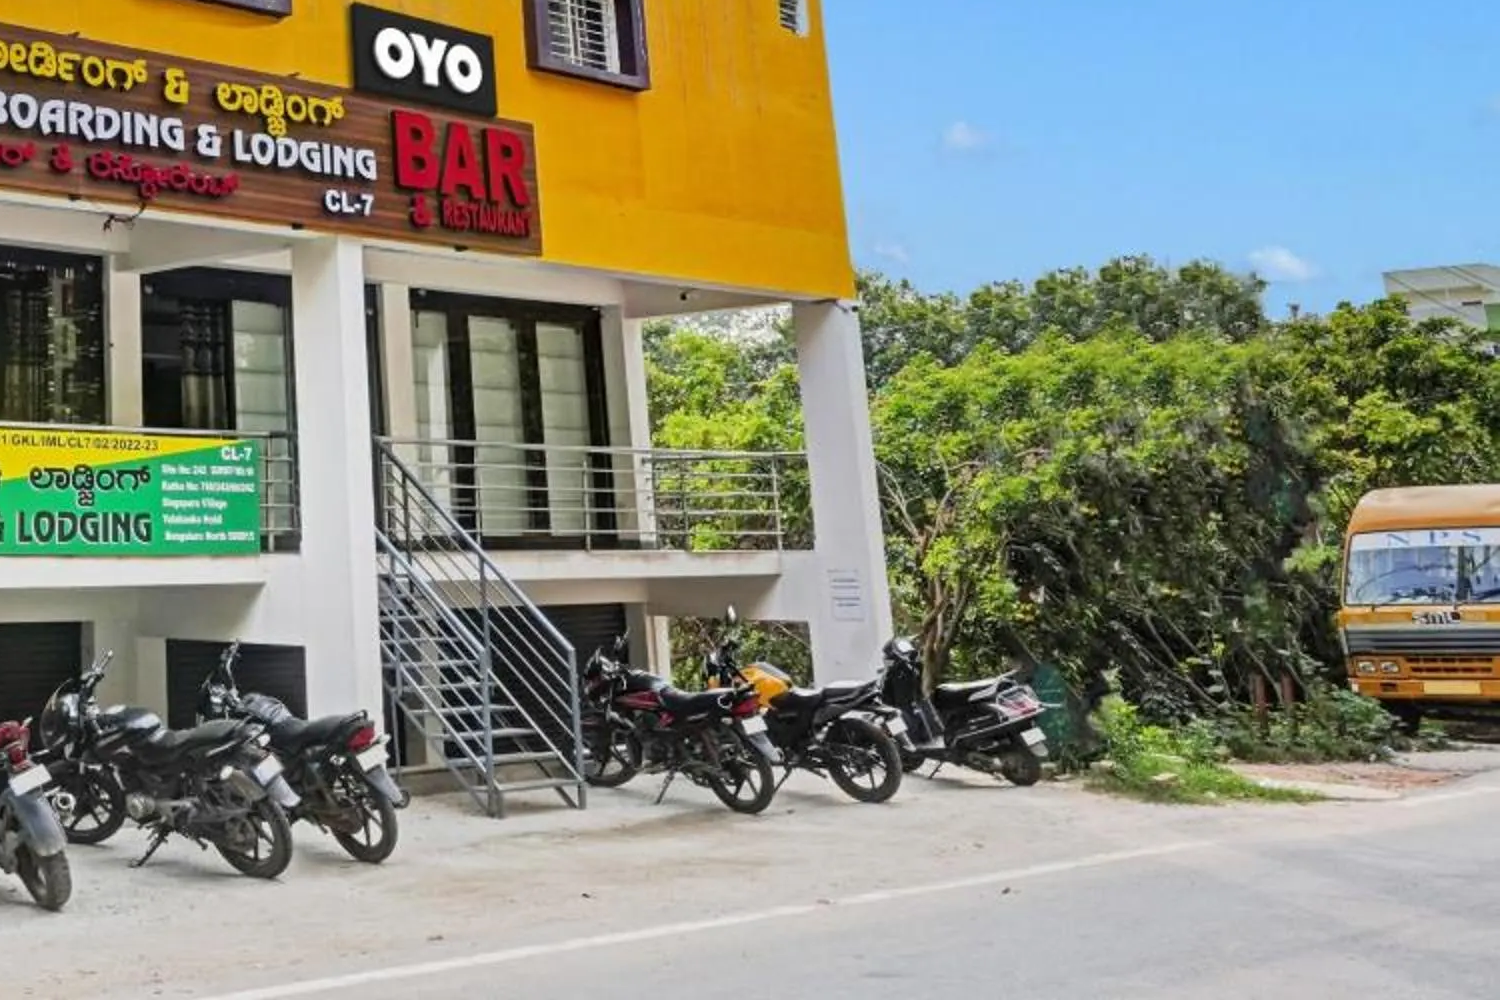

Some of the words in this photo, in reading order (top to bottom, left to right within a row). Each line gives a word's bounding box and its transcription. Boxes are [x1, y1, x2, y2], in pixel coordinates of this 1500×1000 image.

[373, 26, 483, 95] OYO
[164, 68, 190, 105] &
[197, 123, 221, 158] &
[233, 129, 378, 182] LODGING
[392, 108, 530, 207] BAR
[323, 188, 375, 217] CL-7
[442, 197, 530, 237] RESTAURANT
[221, 445, 253, 461] CL-7
[16, 510, 154, 546] LODGING
